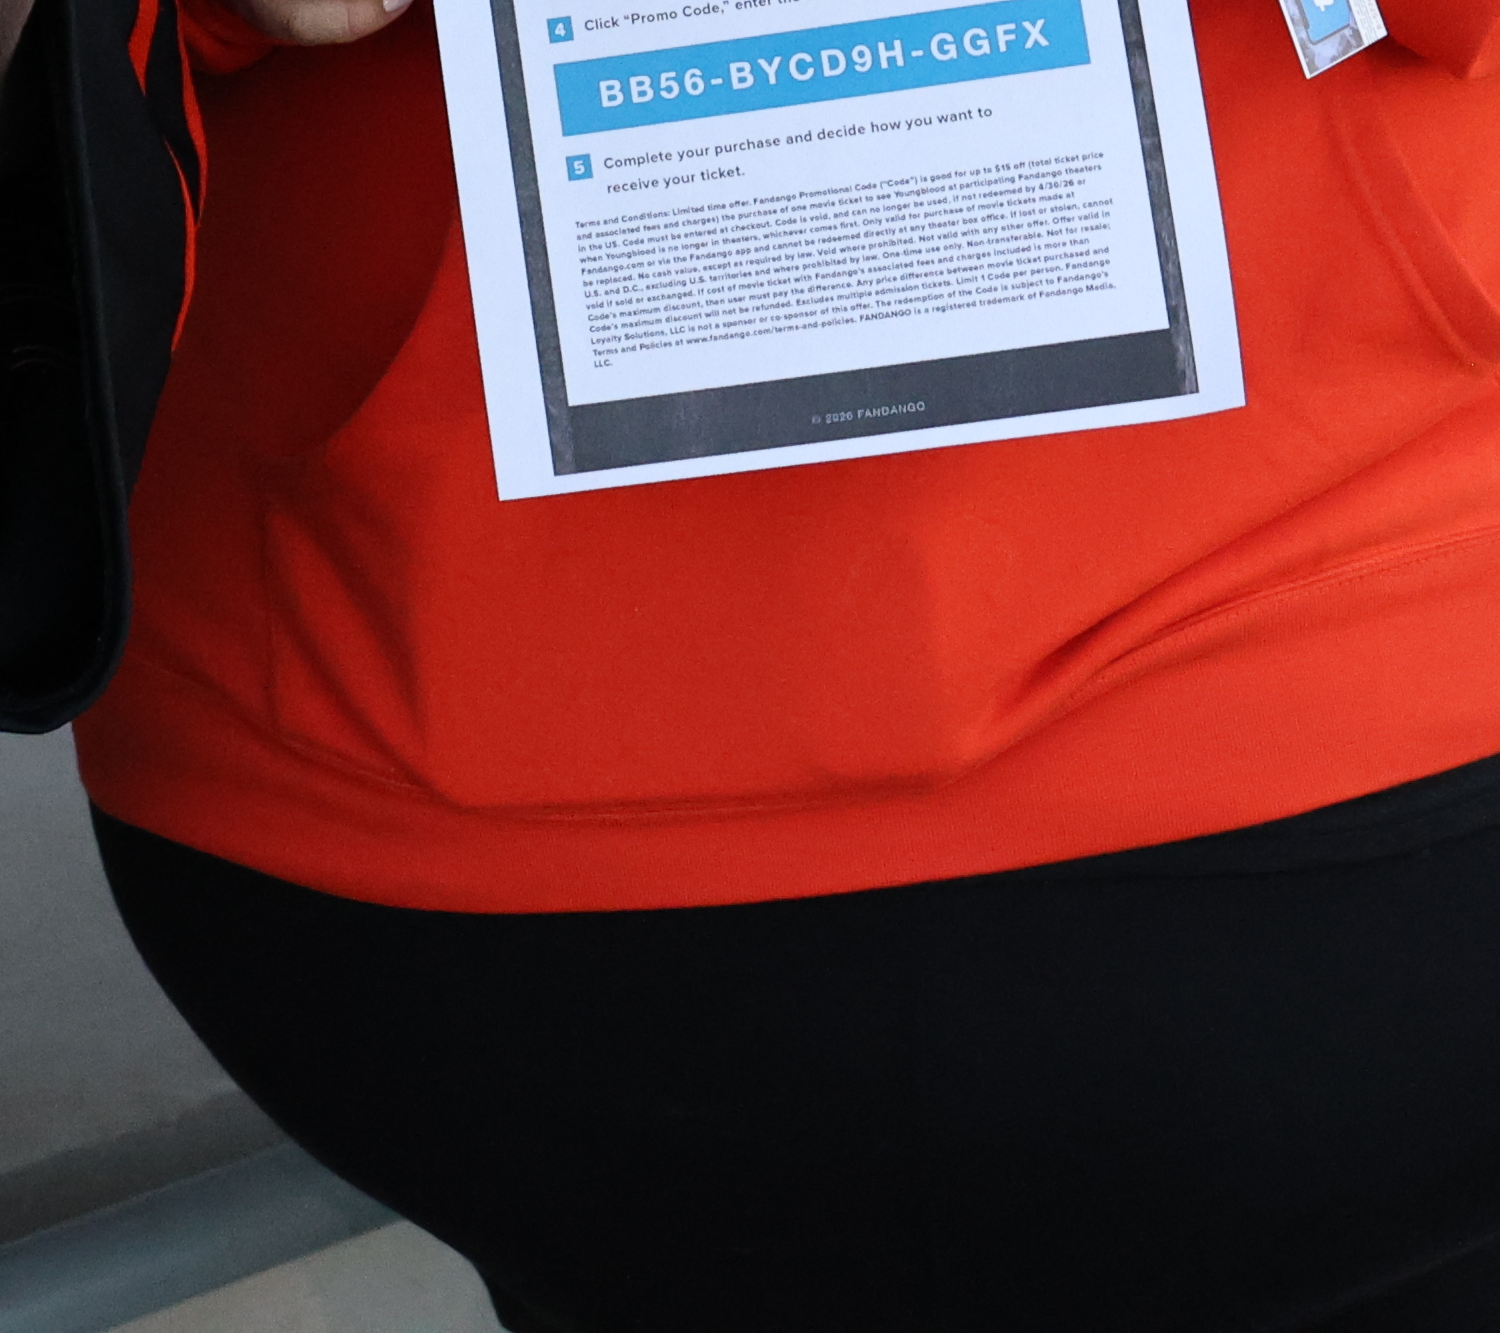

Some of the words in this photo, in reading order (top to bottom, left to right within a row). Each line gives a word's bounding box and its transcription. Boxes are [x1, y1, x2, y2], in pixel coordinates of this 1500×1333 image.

[553, 21, 566, 37] 4
[582, 15, 620, 32] Click
[622, 9, 678, 26] "Promo
[598, 17, 1049, 108] BB56-BYCD9H-GGFX
[572, 159, 585, 175] 5
[602, 150, 673, 170] Complete
[675, 145, 710, 163] your
[713, 136, 781, 158] purchase
[784, 128, 813, 145] and
[815, 122, 866, 141] decide
[868, 119, 902, 133] how
[903, 115, 933, 132] you
[935, 107, 974, 125] want
[976, 106, 993, 119] to
[605, 176, 660, 194] receive
[661, 172, 696, 190] your
[698, 164, 745, 182] ticket.
